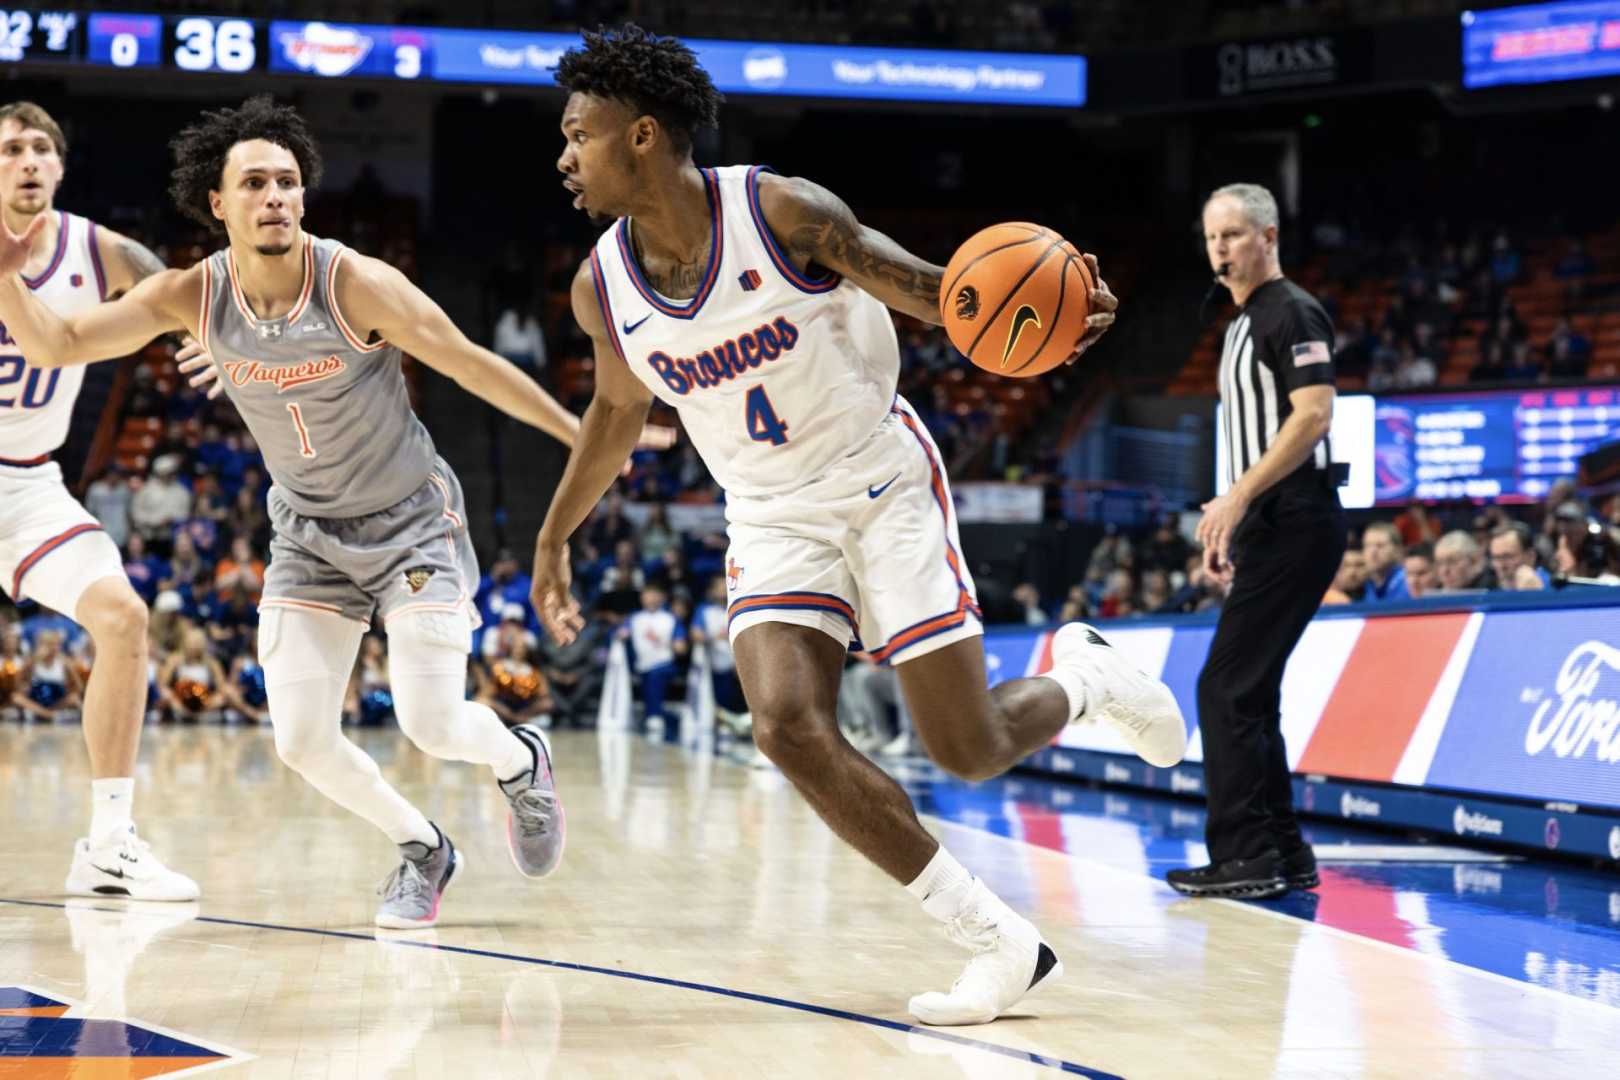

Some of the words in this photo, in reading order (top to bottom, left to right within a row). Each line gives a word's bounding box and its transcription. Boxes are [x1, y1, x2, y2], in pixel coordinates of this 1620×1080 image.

[110, 33, 139, 67] 0
[174, 18, 256, 72] 36
[0, 354, 62, 408] 20
[223, 354, 347, 395] Vaqueros
[647, 315, 799, 395] Broncos
[286, 402, 317, 458] 1
[745, 384, 789, 446] 4
